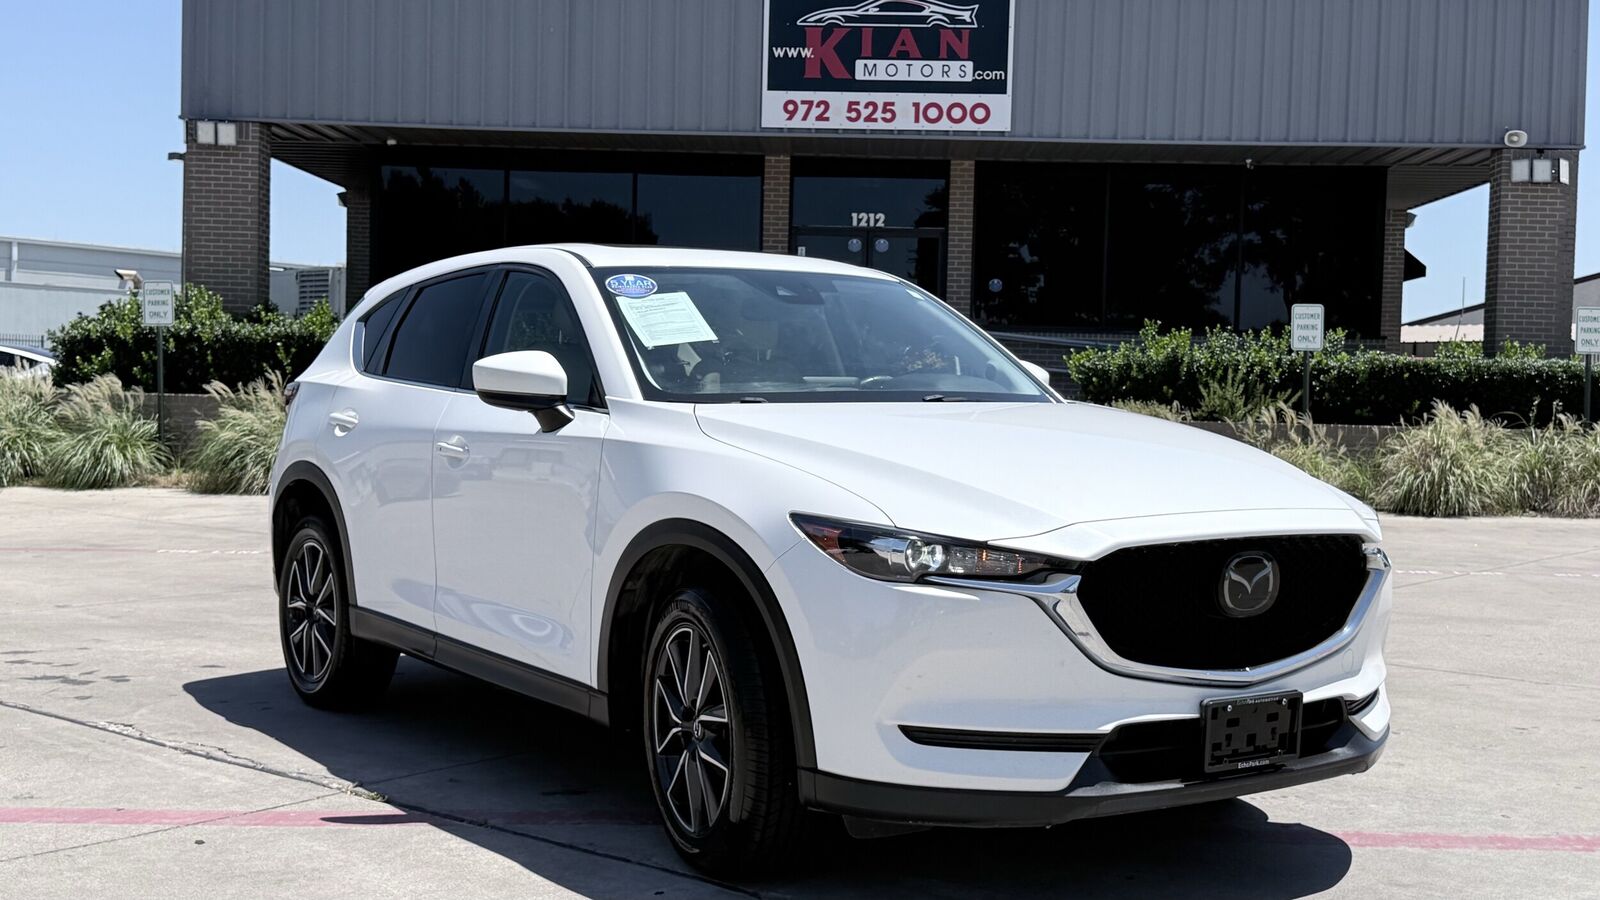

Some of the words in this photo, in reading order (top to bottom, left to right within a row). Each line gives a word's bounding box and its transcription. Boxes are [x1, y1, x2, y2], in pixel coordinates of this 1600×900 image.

[773, 47, 814, 58] www.
[803, 27, 970, 79] KIAN
[863, 63, 967, 78] MOTORS
[783, 99, 830, 121] 972
[846, 100, 896, 123] 525
[912, 102, 991, 124] 1000
[851, 212, 886, 227] 1212
[1579, 315, 1600, 323] CUSTOME
[1297, 335, 1317, 343] ONLY
[1580, 338, 1599, 347] ONLY
